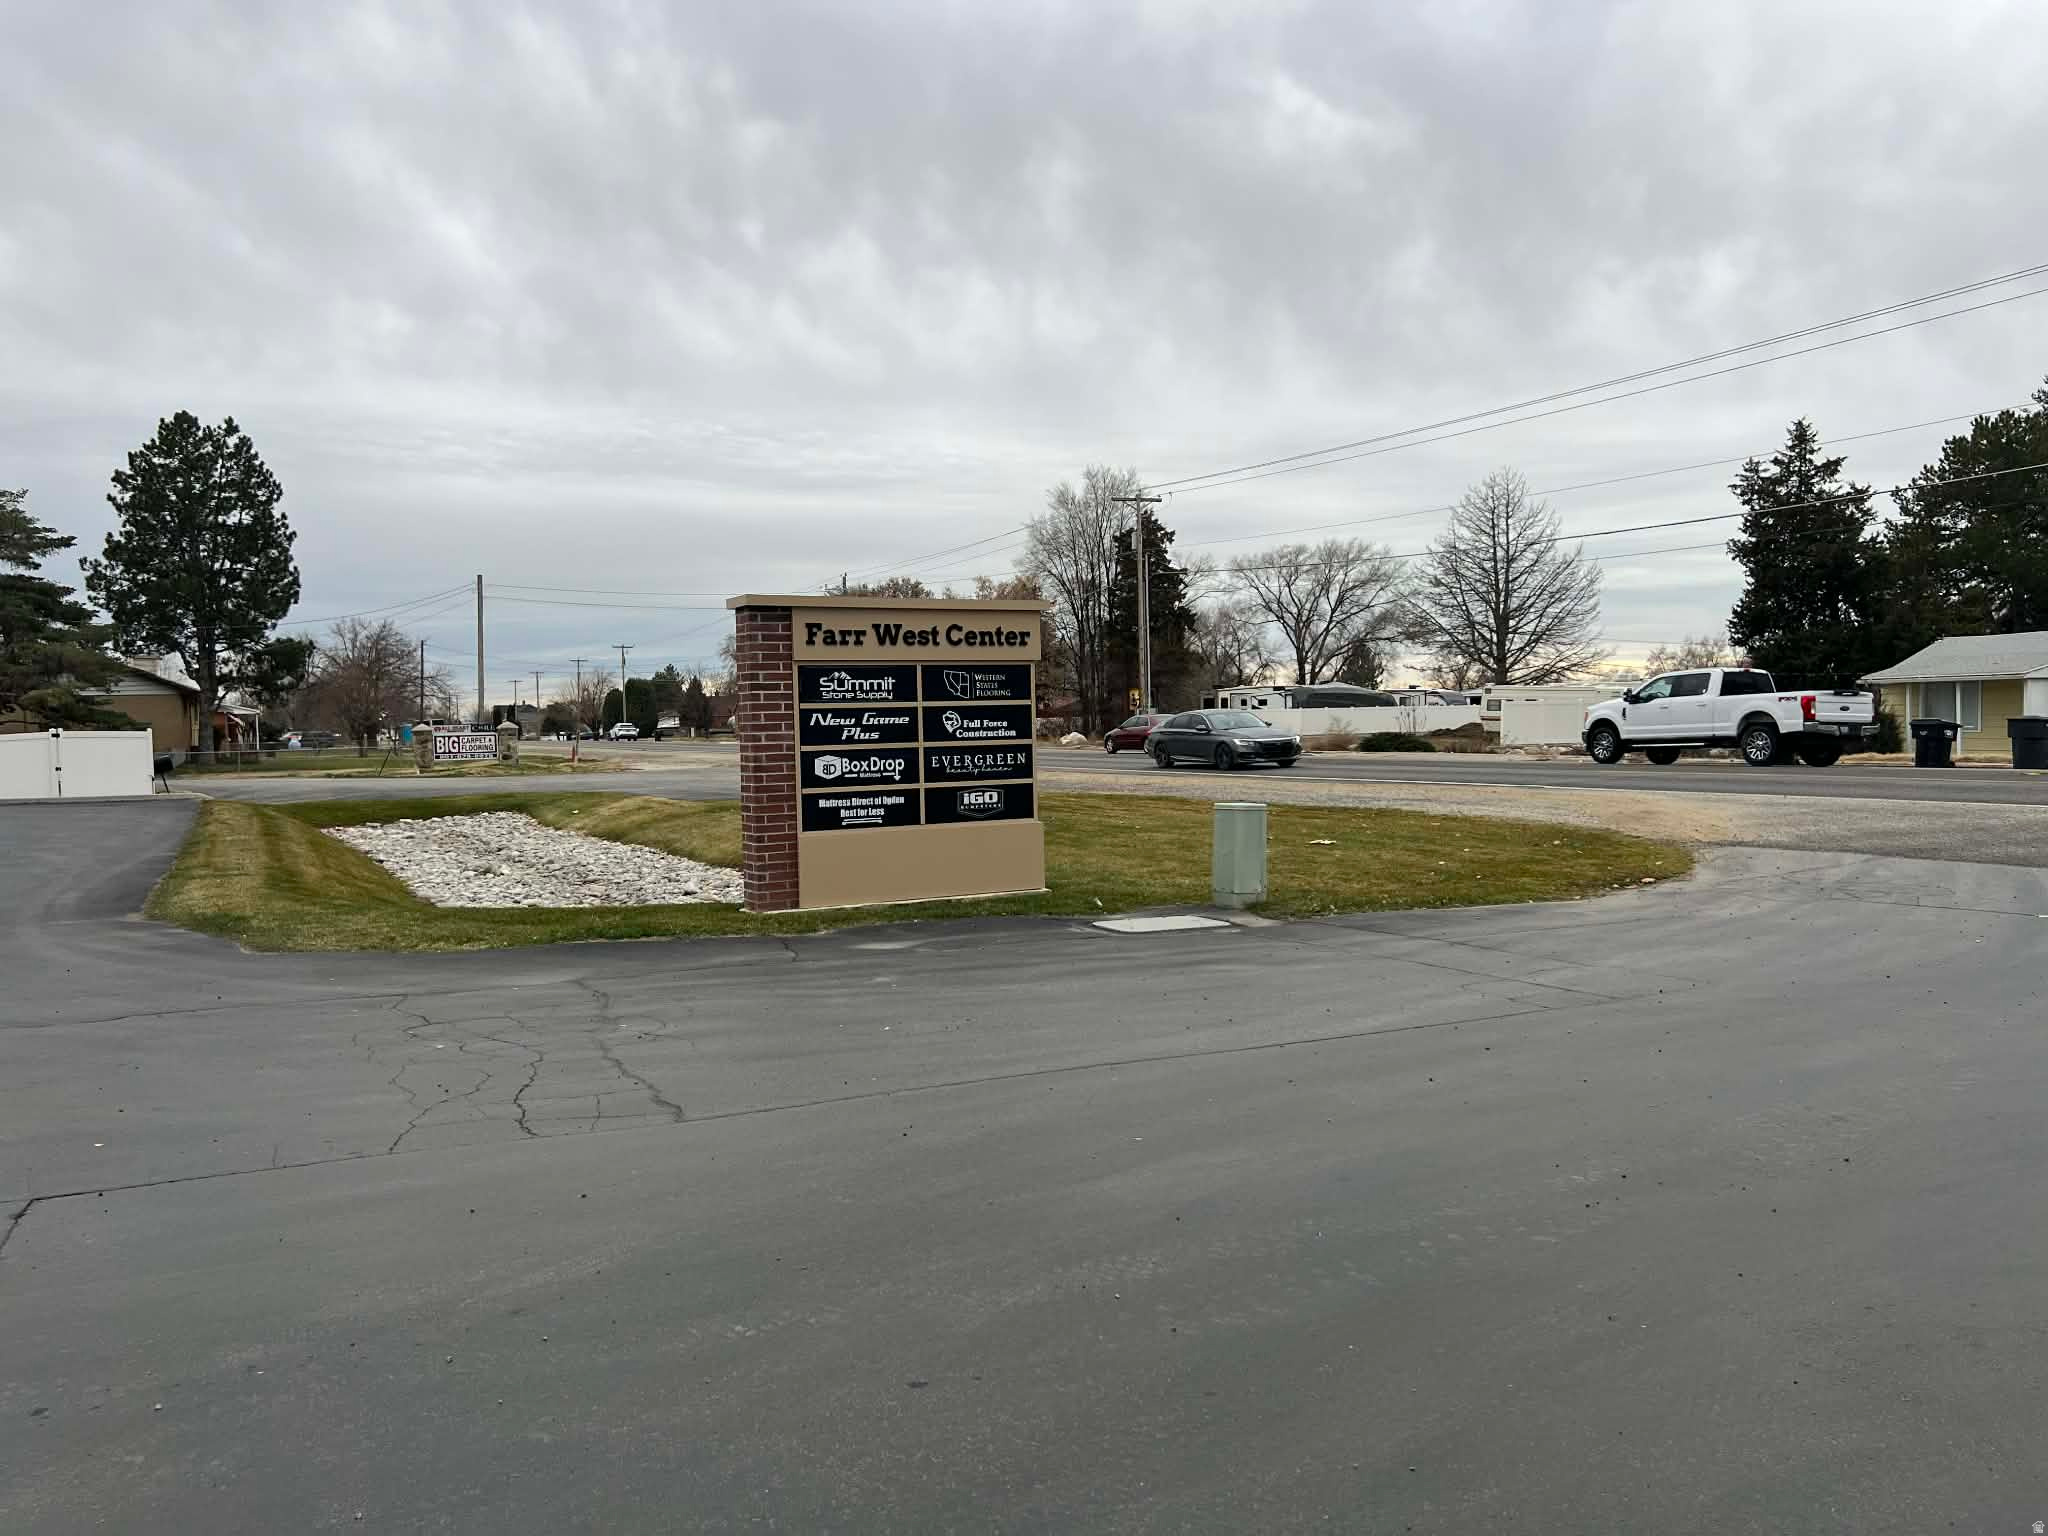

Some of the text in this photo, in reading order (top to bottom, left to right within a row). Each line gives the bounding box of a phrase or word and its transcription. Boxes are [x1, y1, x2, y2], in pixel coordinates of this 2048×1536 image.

[805, 622, 1031, 646] Farr West Center
[821, 690, 893, 700] Stone Supply
[809, 712, 910, 726] New Game
[963, 719, 1008, 728] Full Force
[841, 727, 881, 740] Plus
[956, 728, 1016, 738] Construction
[436, 736, 459, 753] BIG
[461, 744, 494, 752] FLOORING
[931, 753, 1026, 767] EVERGREEN
[818, 798, 851, 808] Mattress
[851, 796, 874, 806] Direct
[874, 795, 882, 805] of
[857, 808, 868, 817] for
[868, 806, 885, 816] Less
